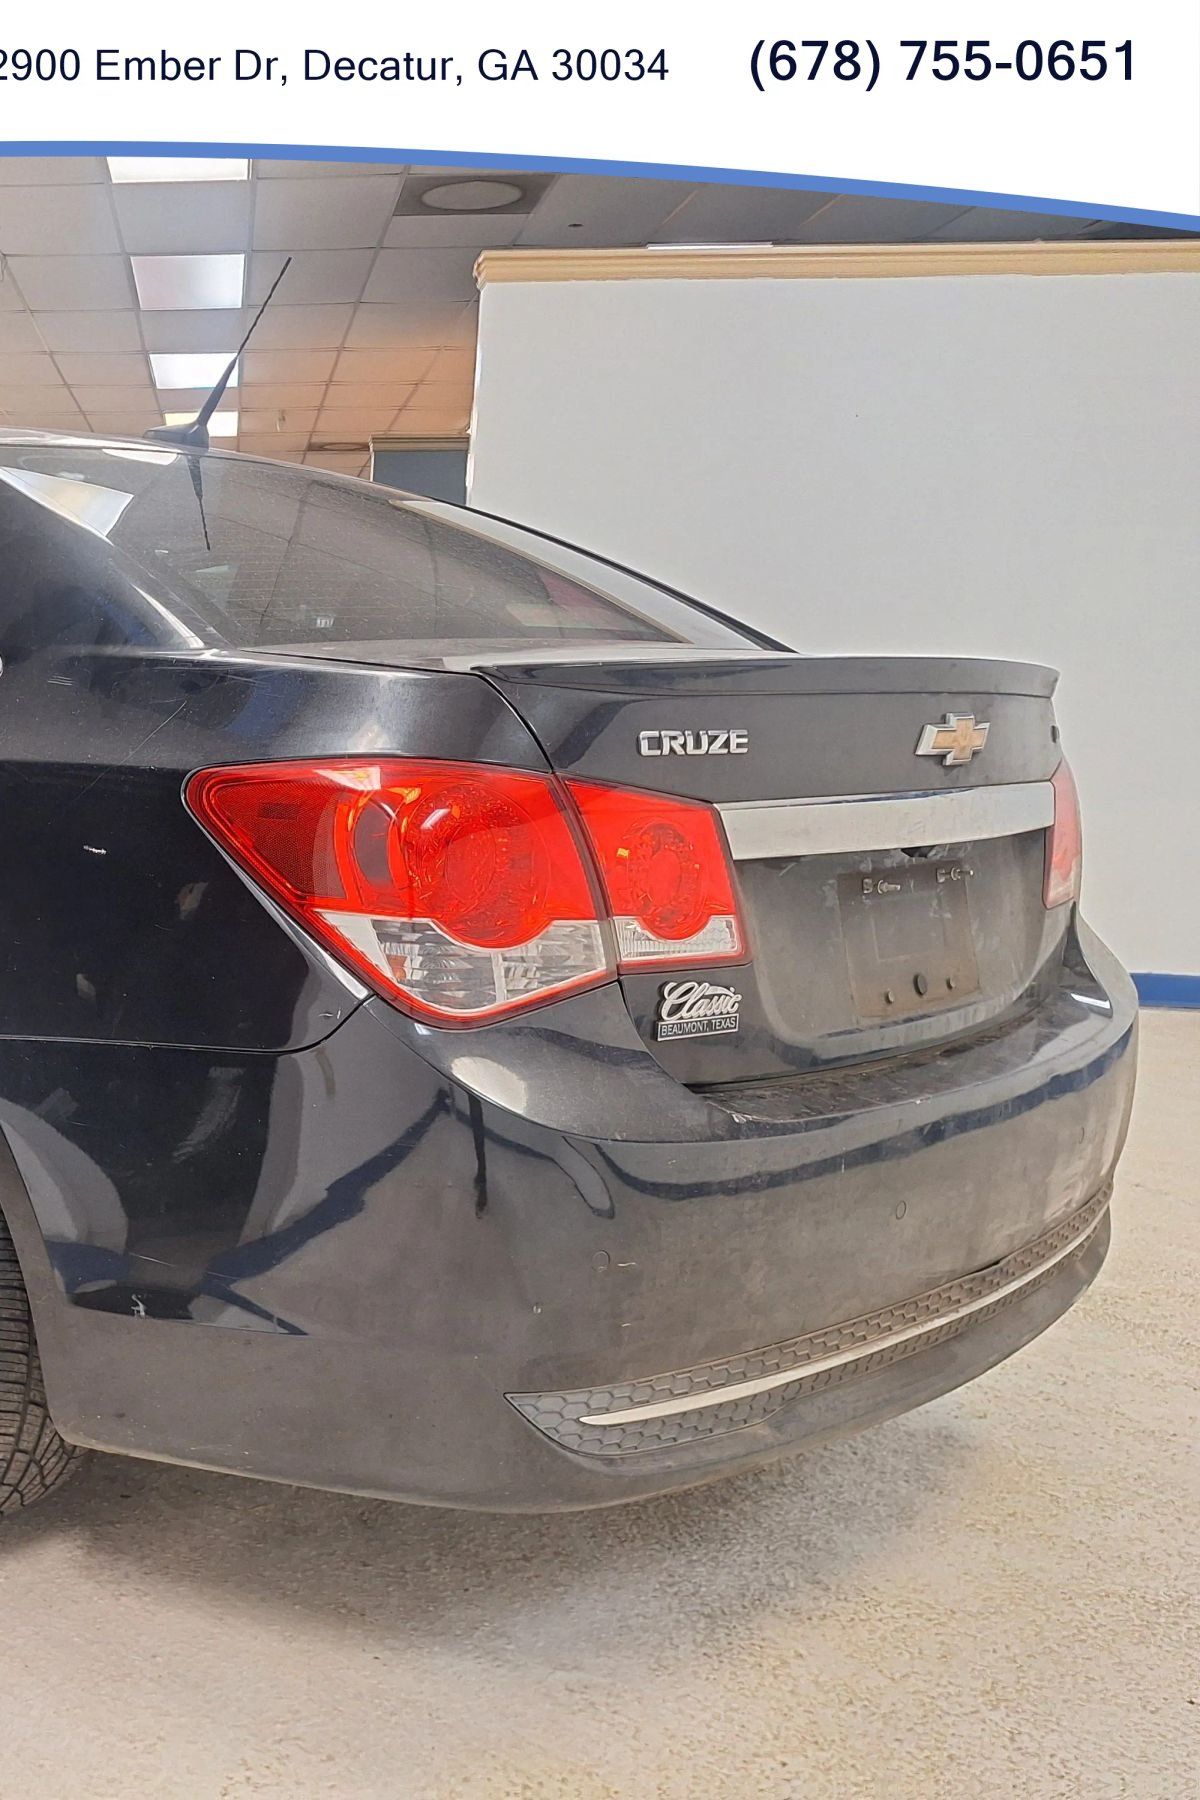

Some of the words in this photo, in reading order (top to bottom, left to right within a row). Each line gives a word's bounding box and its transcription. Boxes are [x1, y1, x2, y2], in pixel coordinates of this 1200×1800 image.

[639, 729, 748, 756] CRUZE
[661, 981, 742, 1021] Classic
[661, 1021, 709, 1036] BEAUMONT,
[712, 1017, 735, 1030] TEXAS
